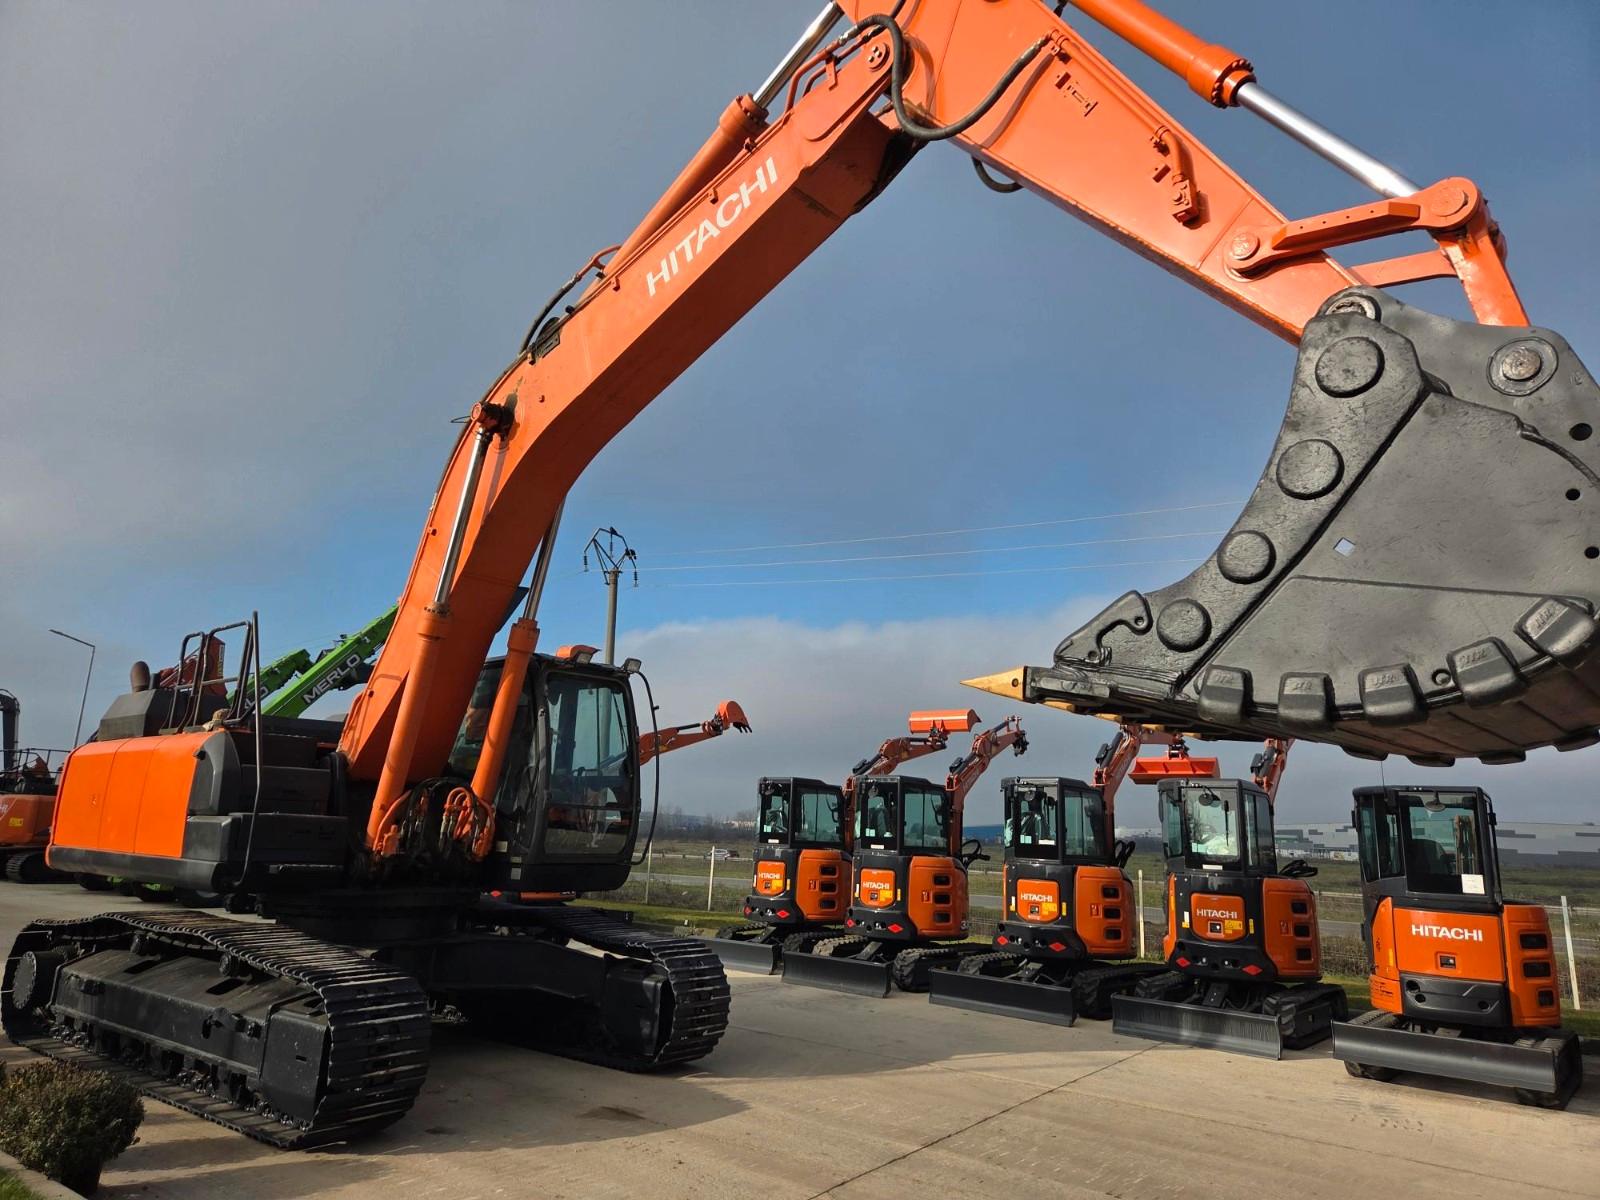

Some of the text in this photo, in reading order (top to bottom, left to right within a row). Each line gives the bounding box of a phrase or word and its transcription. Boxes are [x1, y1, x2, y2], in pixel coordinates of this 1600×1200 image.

[646, 157, 778, 297] HITACHI
[303, 654, 361, 704] MERLO
[862, 881, 890, 890] HITACHI
[1020, 892, 1053, 902] HITACHI
[1196, 908, 1238, 919] HITACHI
[1411, 924, 1484, 942] HITACHI
